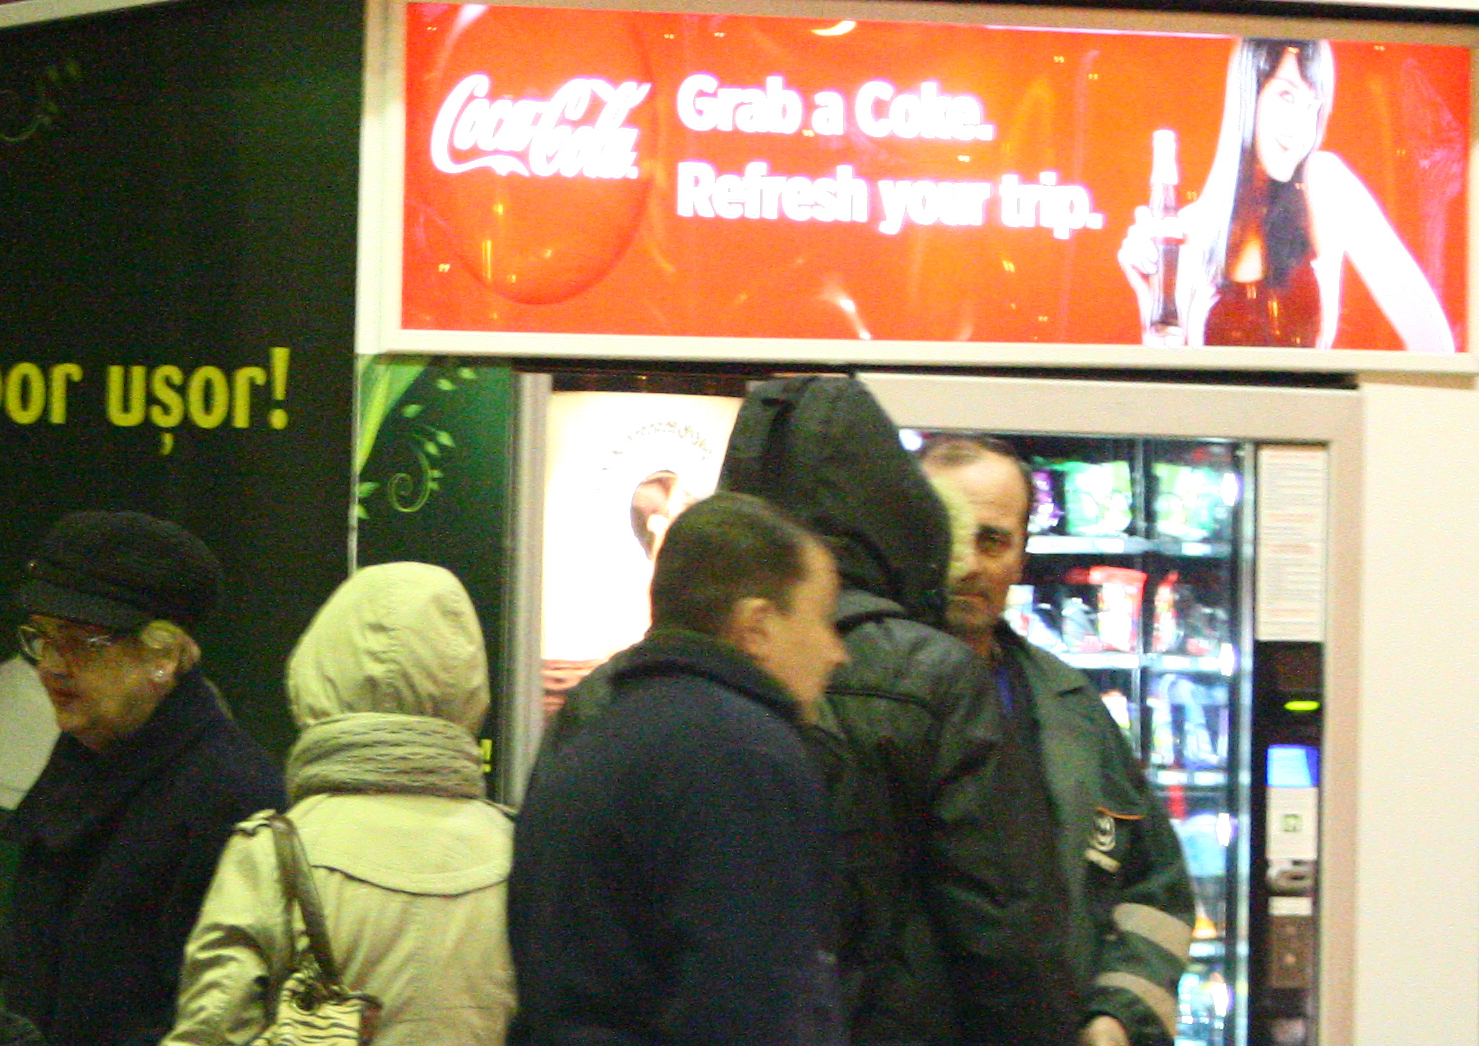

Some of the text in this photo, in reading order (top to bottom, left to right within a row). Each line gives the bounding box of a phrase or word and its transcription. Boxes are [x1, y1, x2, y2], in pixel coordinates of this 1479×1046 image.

[430, 73, 652, 180] Coca-Cola
[677, 74, 996, 142] Grab a Coke.
[677, 160, 1104, 240] Refresh your trip.
[106, 346, 291, 456] ușor!
